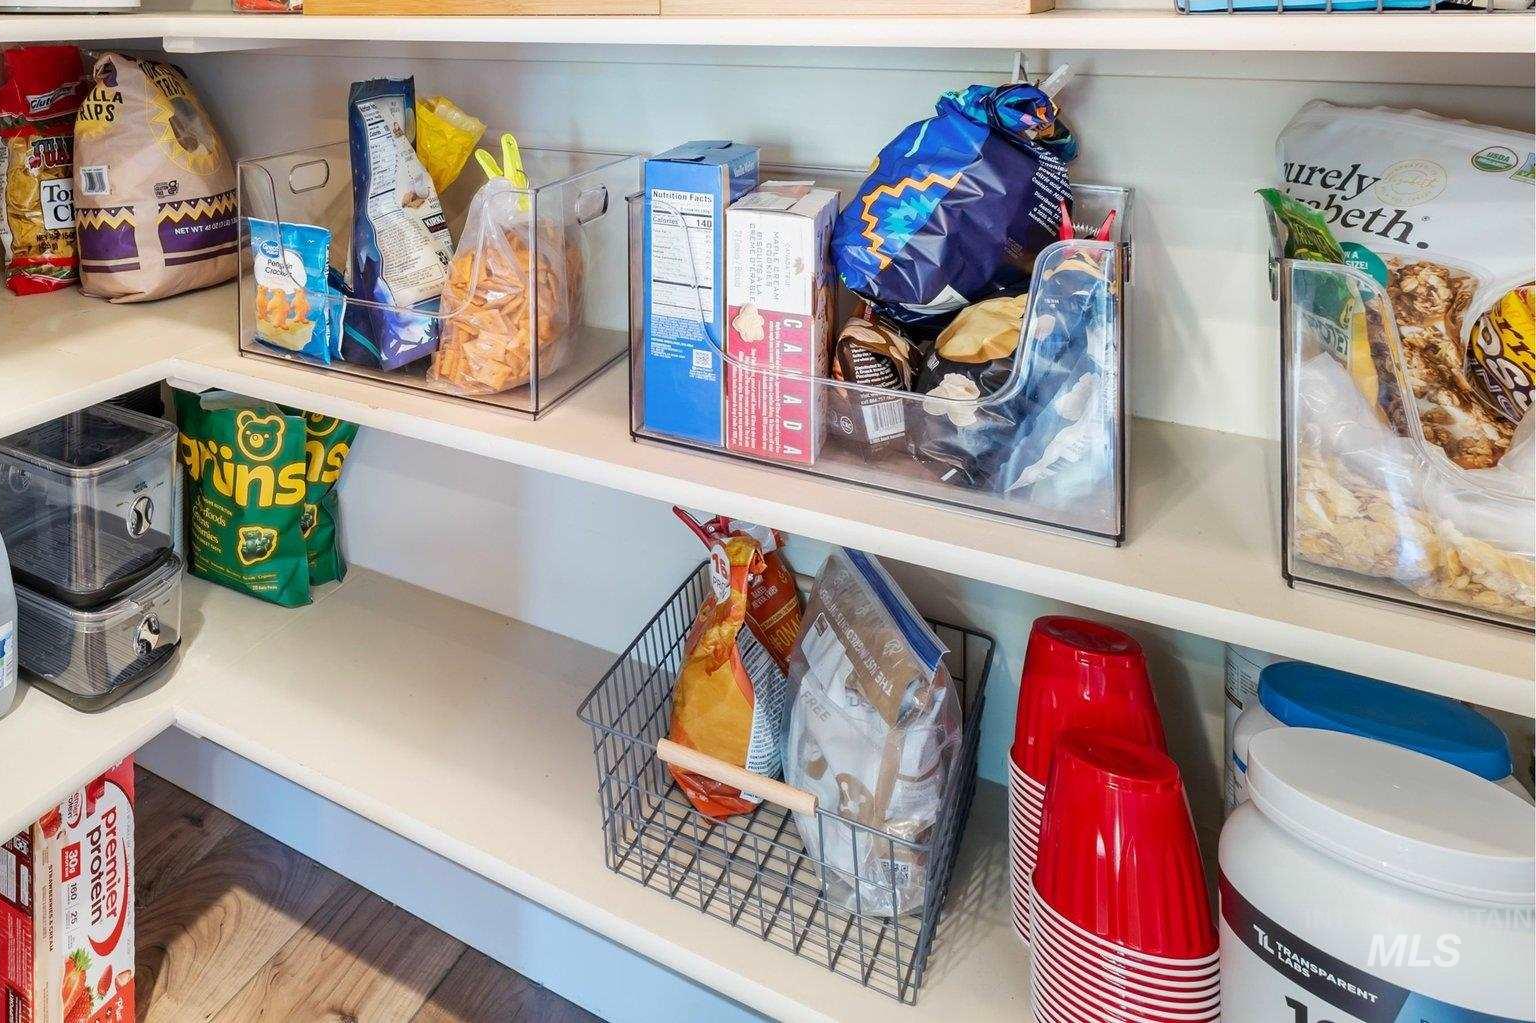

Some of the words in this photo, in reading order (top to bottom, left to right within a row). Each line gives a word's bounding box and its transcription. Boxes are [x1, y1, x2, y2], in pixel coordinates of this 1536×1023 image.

[1486, 150, 1512, 162] USDA
[653, 190, 688, 201] Nutrition
[689, 193, 713, 203] Facts
[174, 226, 190, 236] NET
[190, 225, 204, 234] WT
[696, 219, 712, 228] 140
[266, 259, 294, 271] Penguin
[1345, 259, 1369, 270] SIZE!
[782, 317, 804, 456] CANADA
[68, 846, 79, 876] 30g
[101, 805, 117, 919] premier
[86, 824, 104, 927] protein
[1252, 923, 1275, 956] TL
[1275, 940, 1379, 1004] TRANSPARENT
[1277, 951, 1312, 978] LABS
